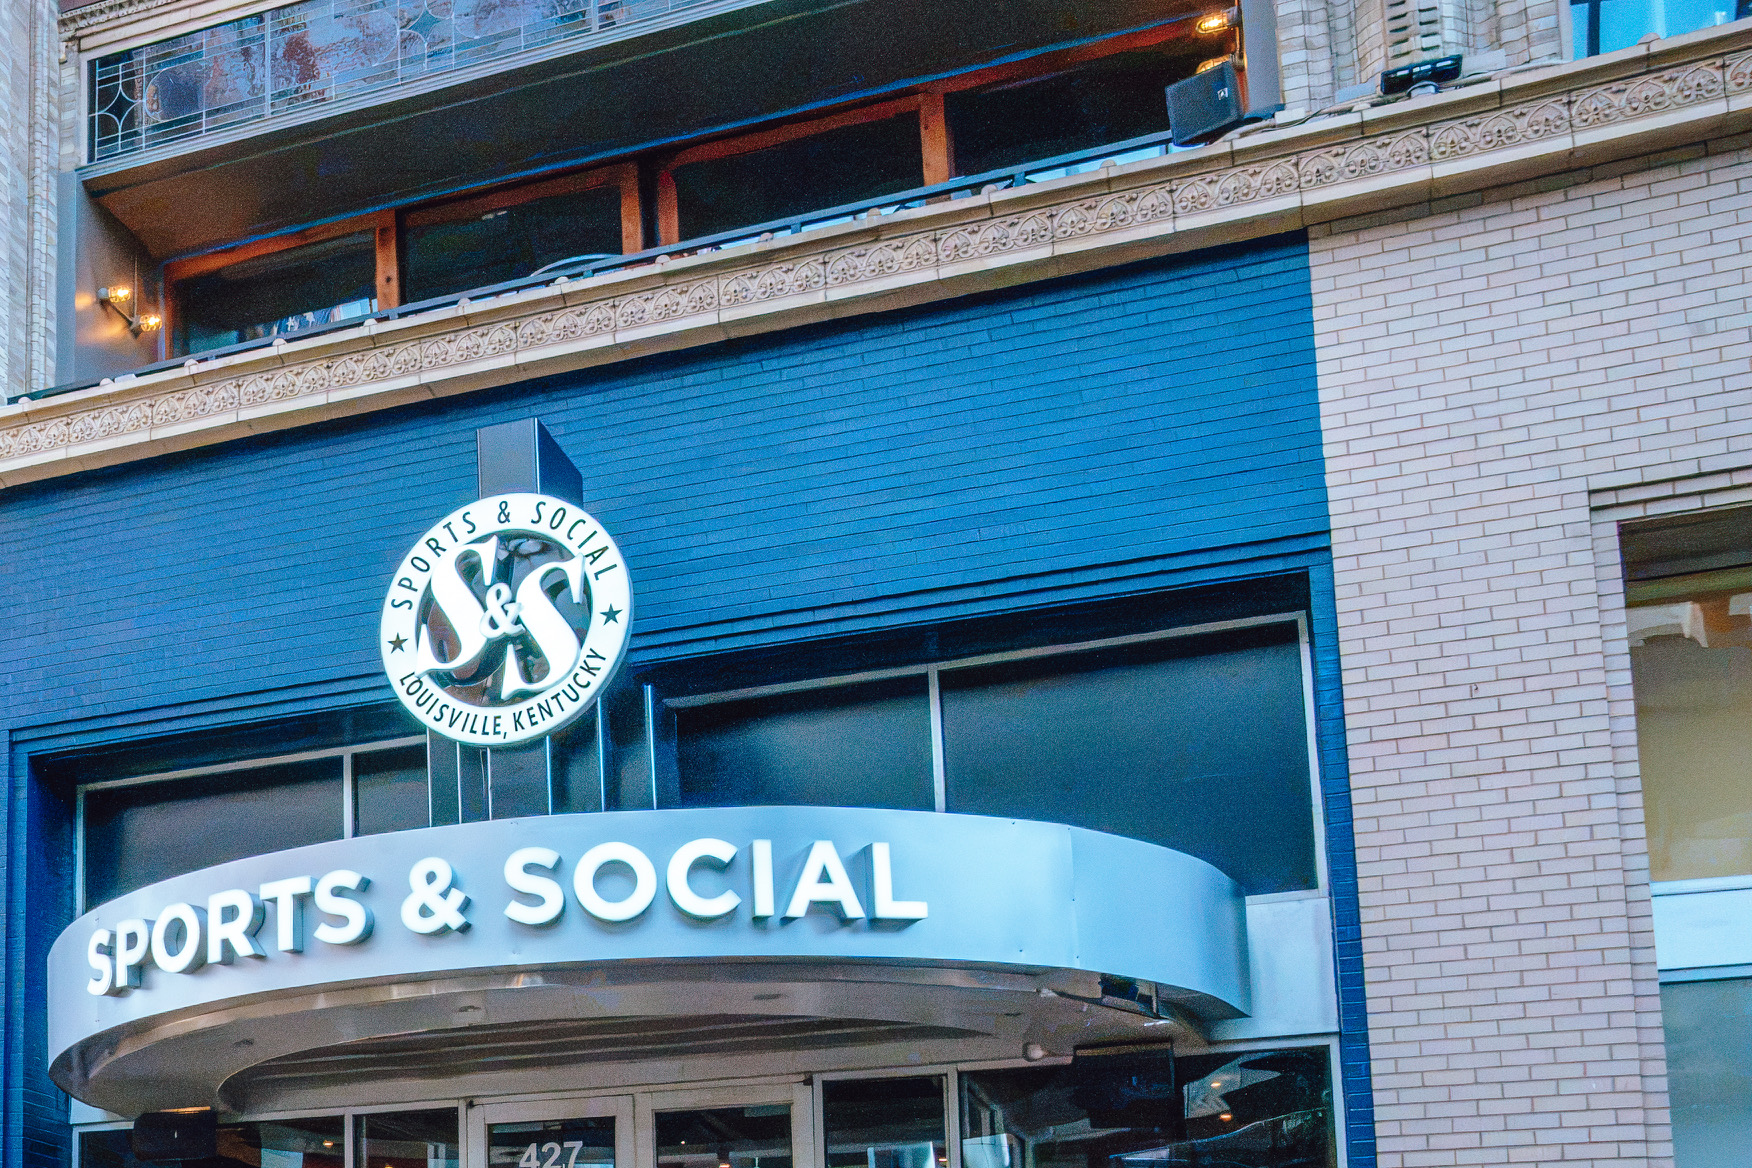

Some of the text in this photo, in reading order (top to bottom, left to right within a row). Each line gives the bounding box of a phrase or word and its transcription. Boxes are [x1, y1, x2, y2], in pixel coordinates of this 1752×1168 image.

[390, 500, 618, 611] SPORTS & SOCIAL
[399, 647, 607, 739] LOUISVILLE, KENTUCKY
[86, 837, 930, 997] SPORTS & SOCIAL
